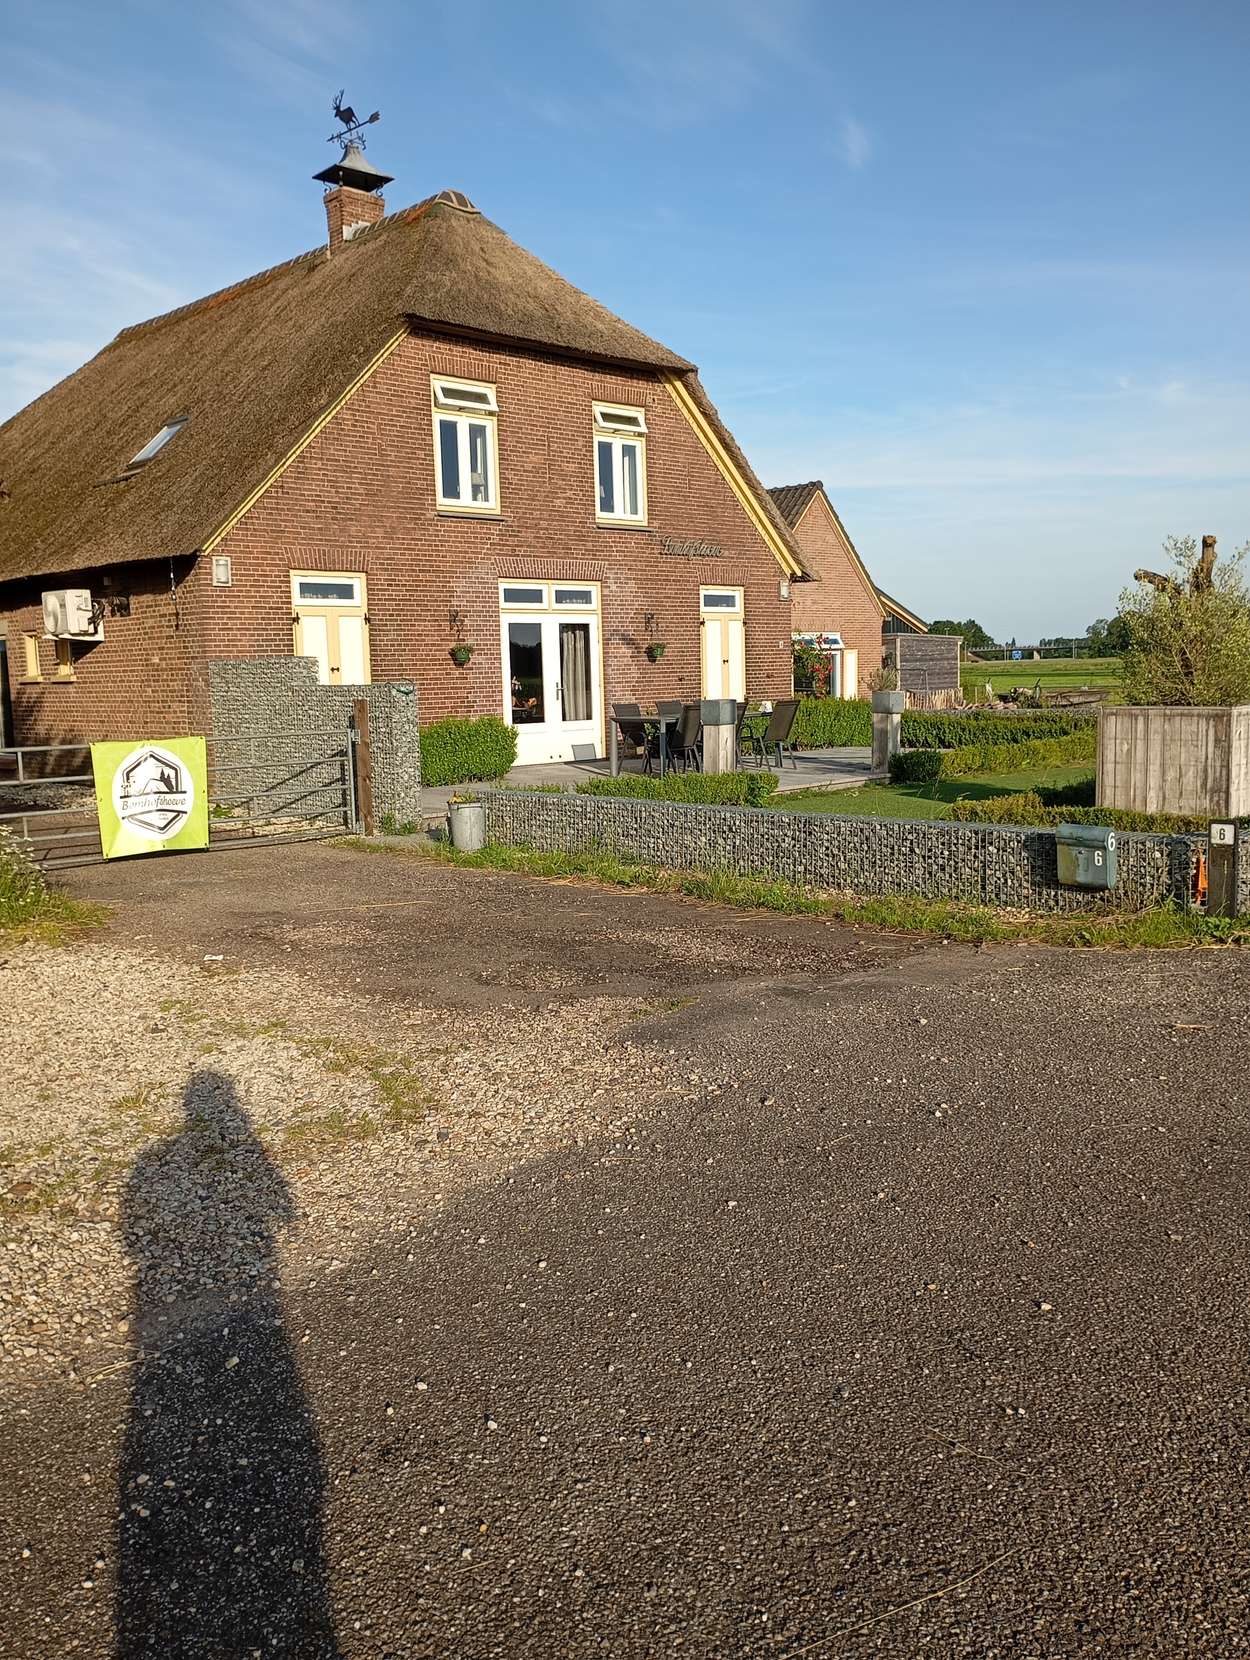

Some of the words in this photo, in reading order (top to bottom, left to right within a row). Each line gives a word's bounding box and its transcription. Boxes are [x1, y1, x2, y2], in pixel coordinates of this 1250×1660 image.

[1108, 832, 1116, 851] 6
[1219, 828, 1226, 841] 6
[1095, 850, 1103, 866] 6
